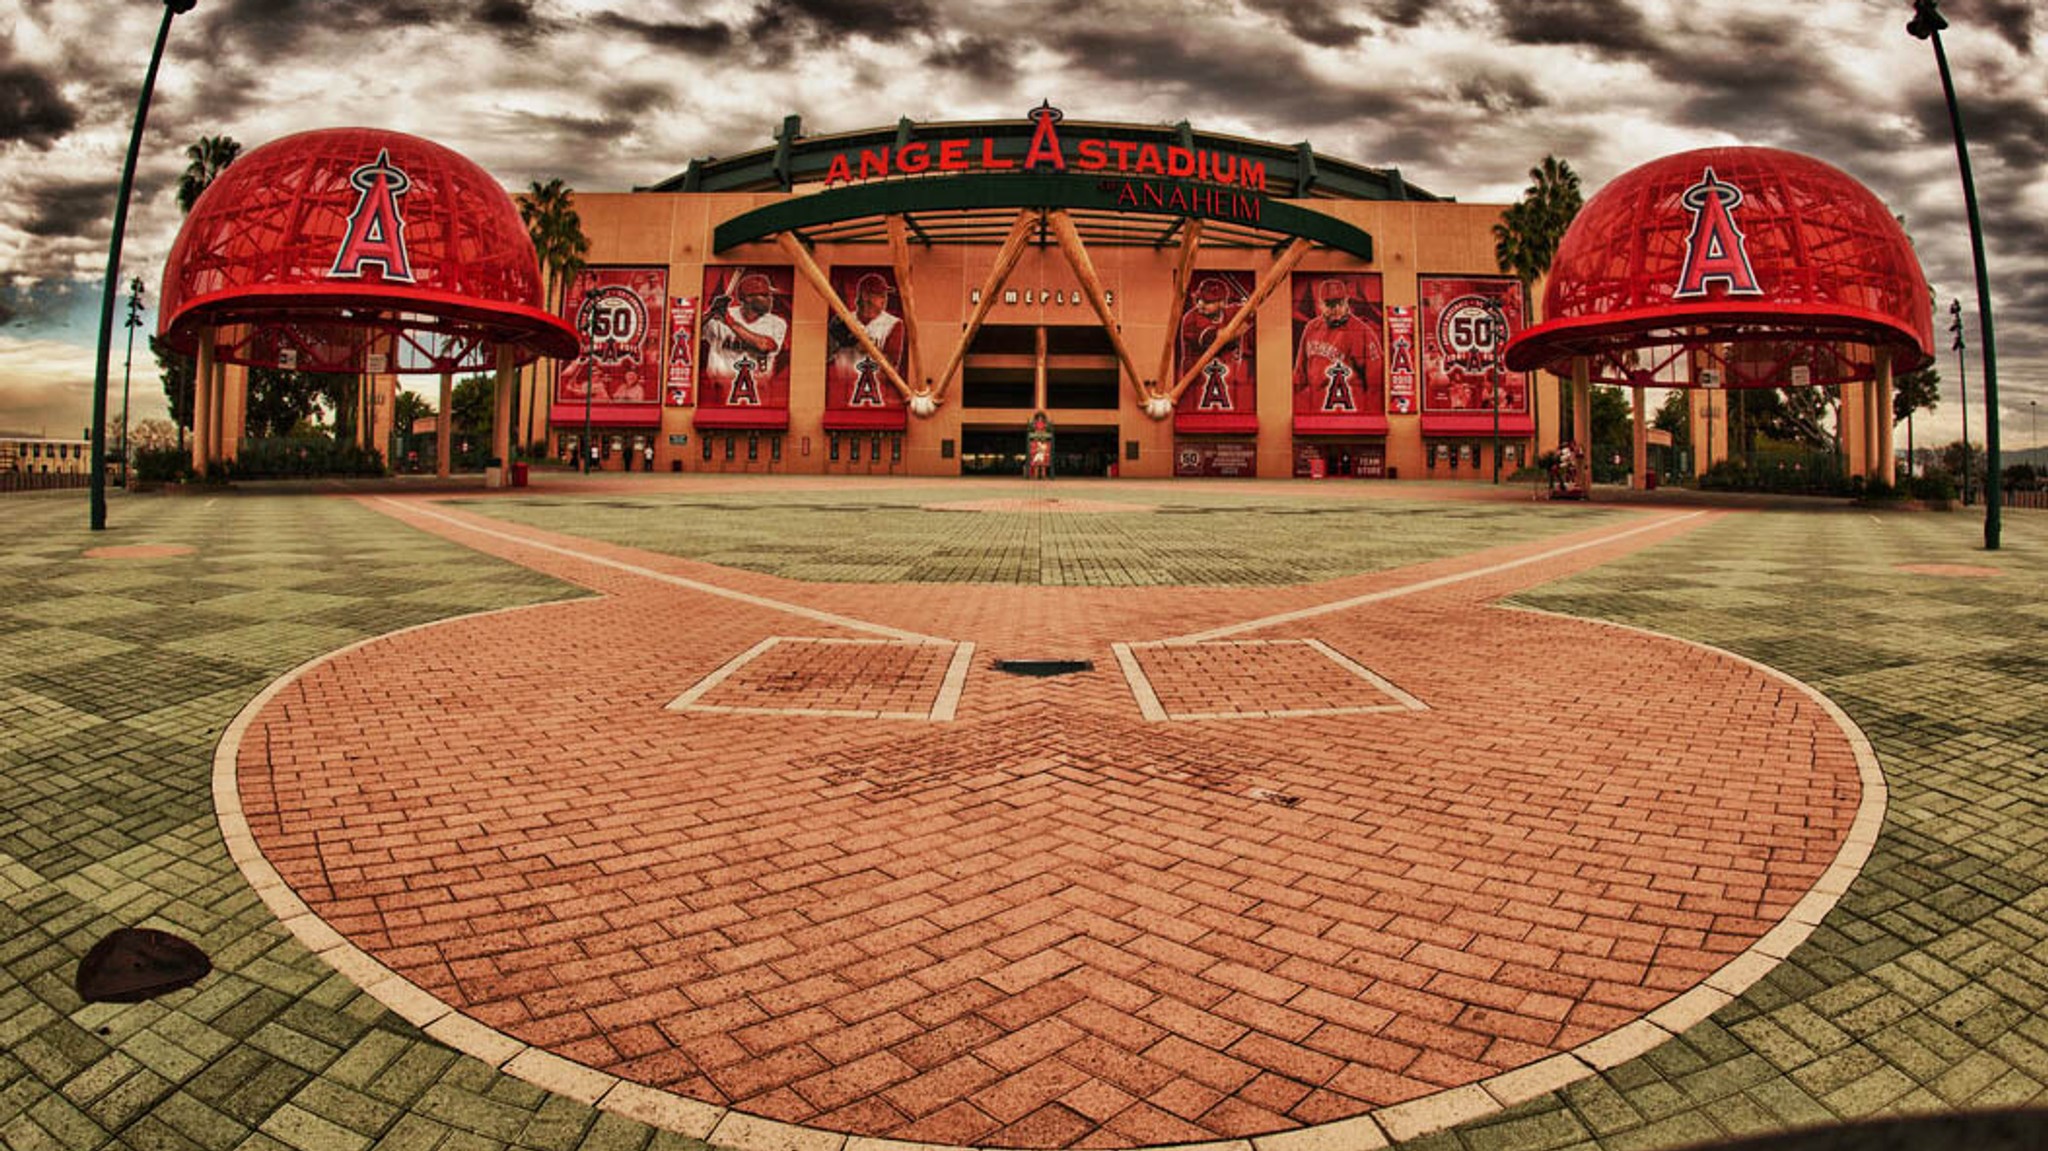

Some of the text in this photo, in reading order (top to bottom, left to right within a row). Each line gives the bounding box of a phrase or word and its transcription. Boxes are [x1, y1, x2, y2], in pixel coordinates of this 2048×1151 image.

[824, 137, 1014, 186] ANGEL
[1077, 137, 1267, 191] STADIUM
[328, 147, 416, 283] A
[1117, 181, 1262, 223] ANAHEIM
[1673, 165, 1764, 298] A
[1454, 317, 1492, 347] 50
[728, 354, 761, 406] A
[850, 355, 884, 406] A
[1197, 359, 1234, 411] A
[1321, 359, 1357, 412] A
